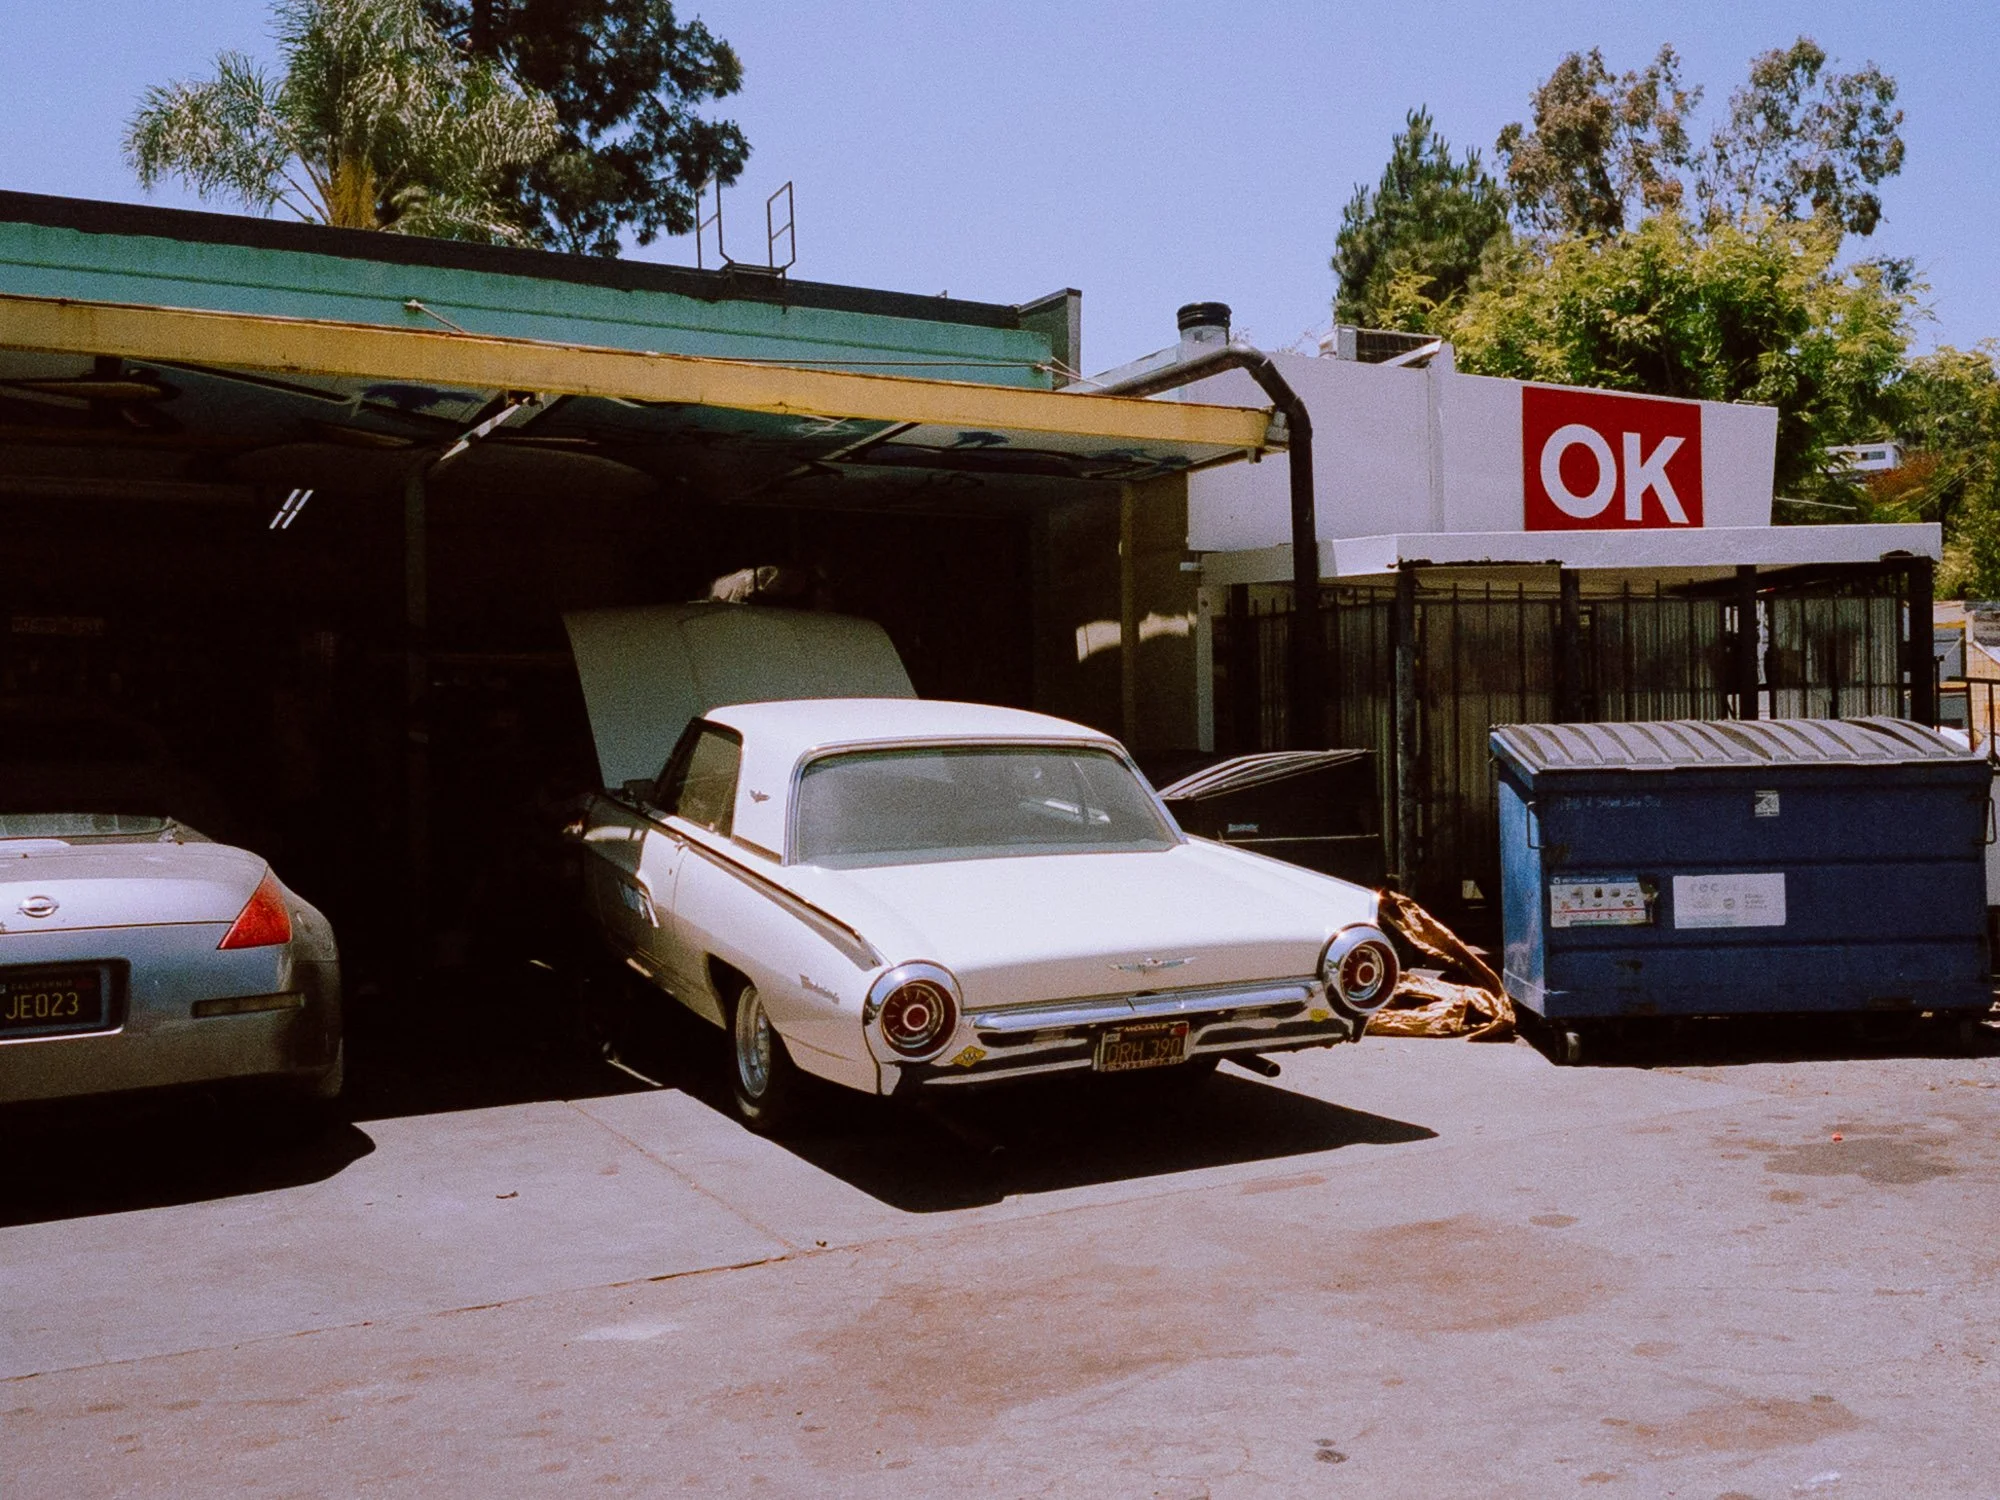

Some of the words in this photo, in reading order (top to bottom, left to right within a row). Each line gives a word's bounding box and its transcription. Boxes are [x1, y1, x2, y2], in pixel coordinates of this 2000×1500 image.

[1540, 423, 1690, 525] OK
[5, 991, 79, 1020] JE023
[1150, 1038, 1181, 1059] 390
